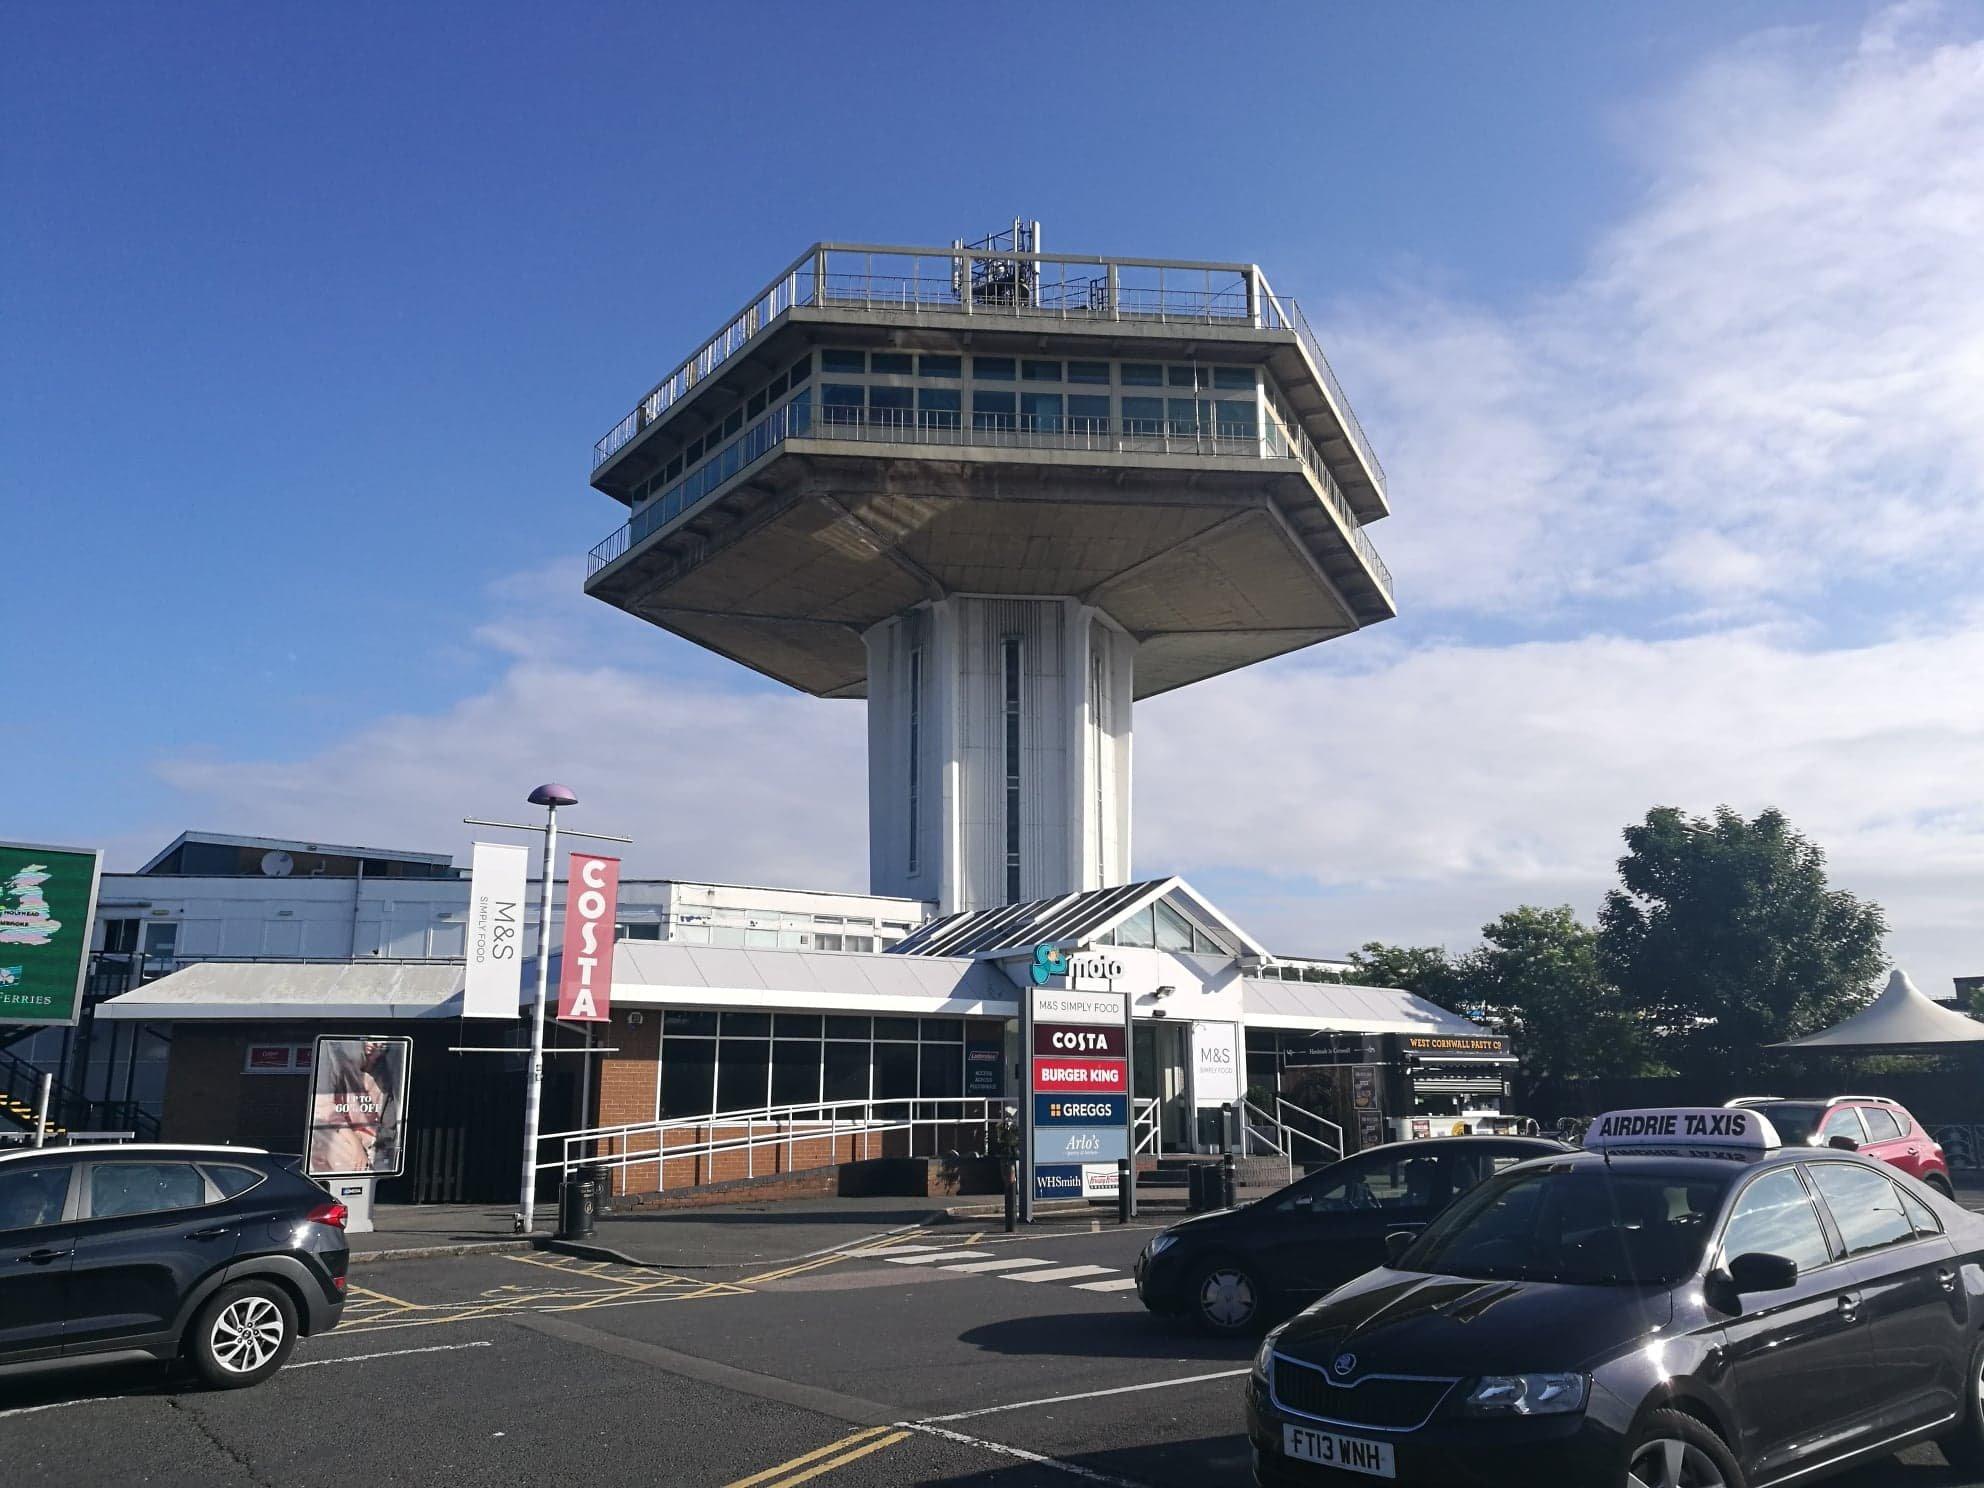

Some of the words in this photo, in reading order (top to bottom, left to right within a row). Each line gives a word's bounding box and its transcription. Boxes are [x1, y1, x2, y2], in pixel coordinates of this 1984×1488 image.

[478, 896, 488, 931] SIMPLY
[492, 901, 517, 960] M&S
[570, 859, 607, 1017] COSTA
[476, 934, 486, 963] FOOD
[1067, 955, 1125, 979] moto
[1039, 1000, 1058, 1011] M&S
[1060, 1001, 1092, 1011] SIMPLY
[1094, 1003, 1119, 1013] FOOD
[1052, 1032, 1108, 1051] COSTA
[1410, 1038, 1431, 1048] WEST
[1431, 1039, 1471, 1049] CORNWALL
[1471, 1040, 1492, 1049] PASTY
[1201, 1047, 1231, 1064] M&S
[1041, 1068, 1088, 1082] BURGER
[1090, 1069, 1119, 1083] KING
[1063, 1103, 1112, 1117] GREGGS
[1599, 1115, 1678, 1137] AIRDRIE
[1684, 1114, 1746, 1136] TAXIS
[1065, 1134, 1100, 1150] Arlo's
[1037, 1175, 1081, 1188] WHSmith
[1293, 1429, 1334, 1460] FT13
[1339, 1439, 1381, 1471] WNH
